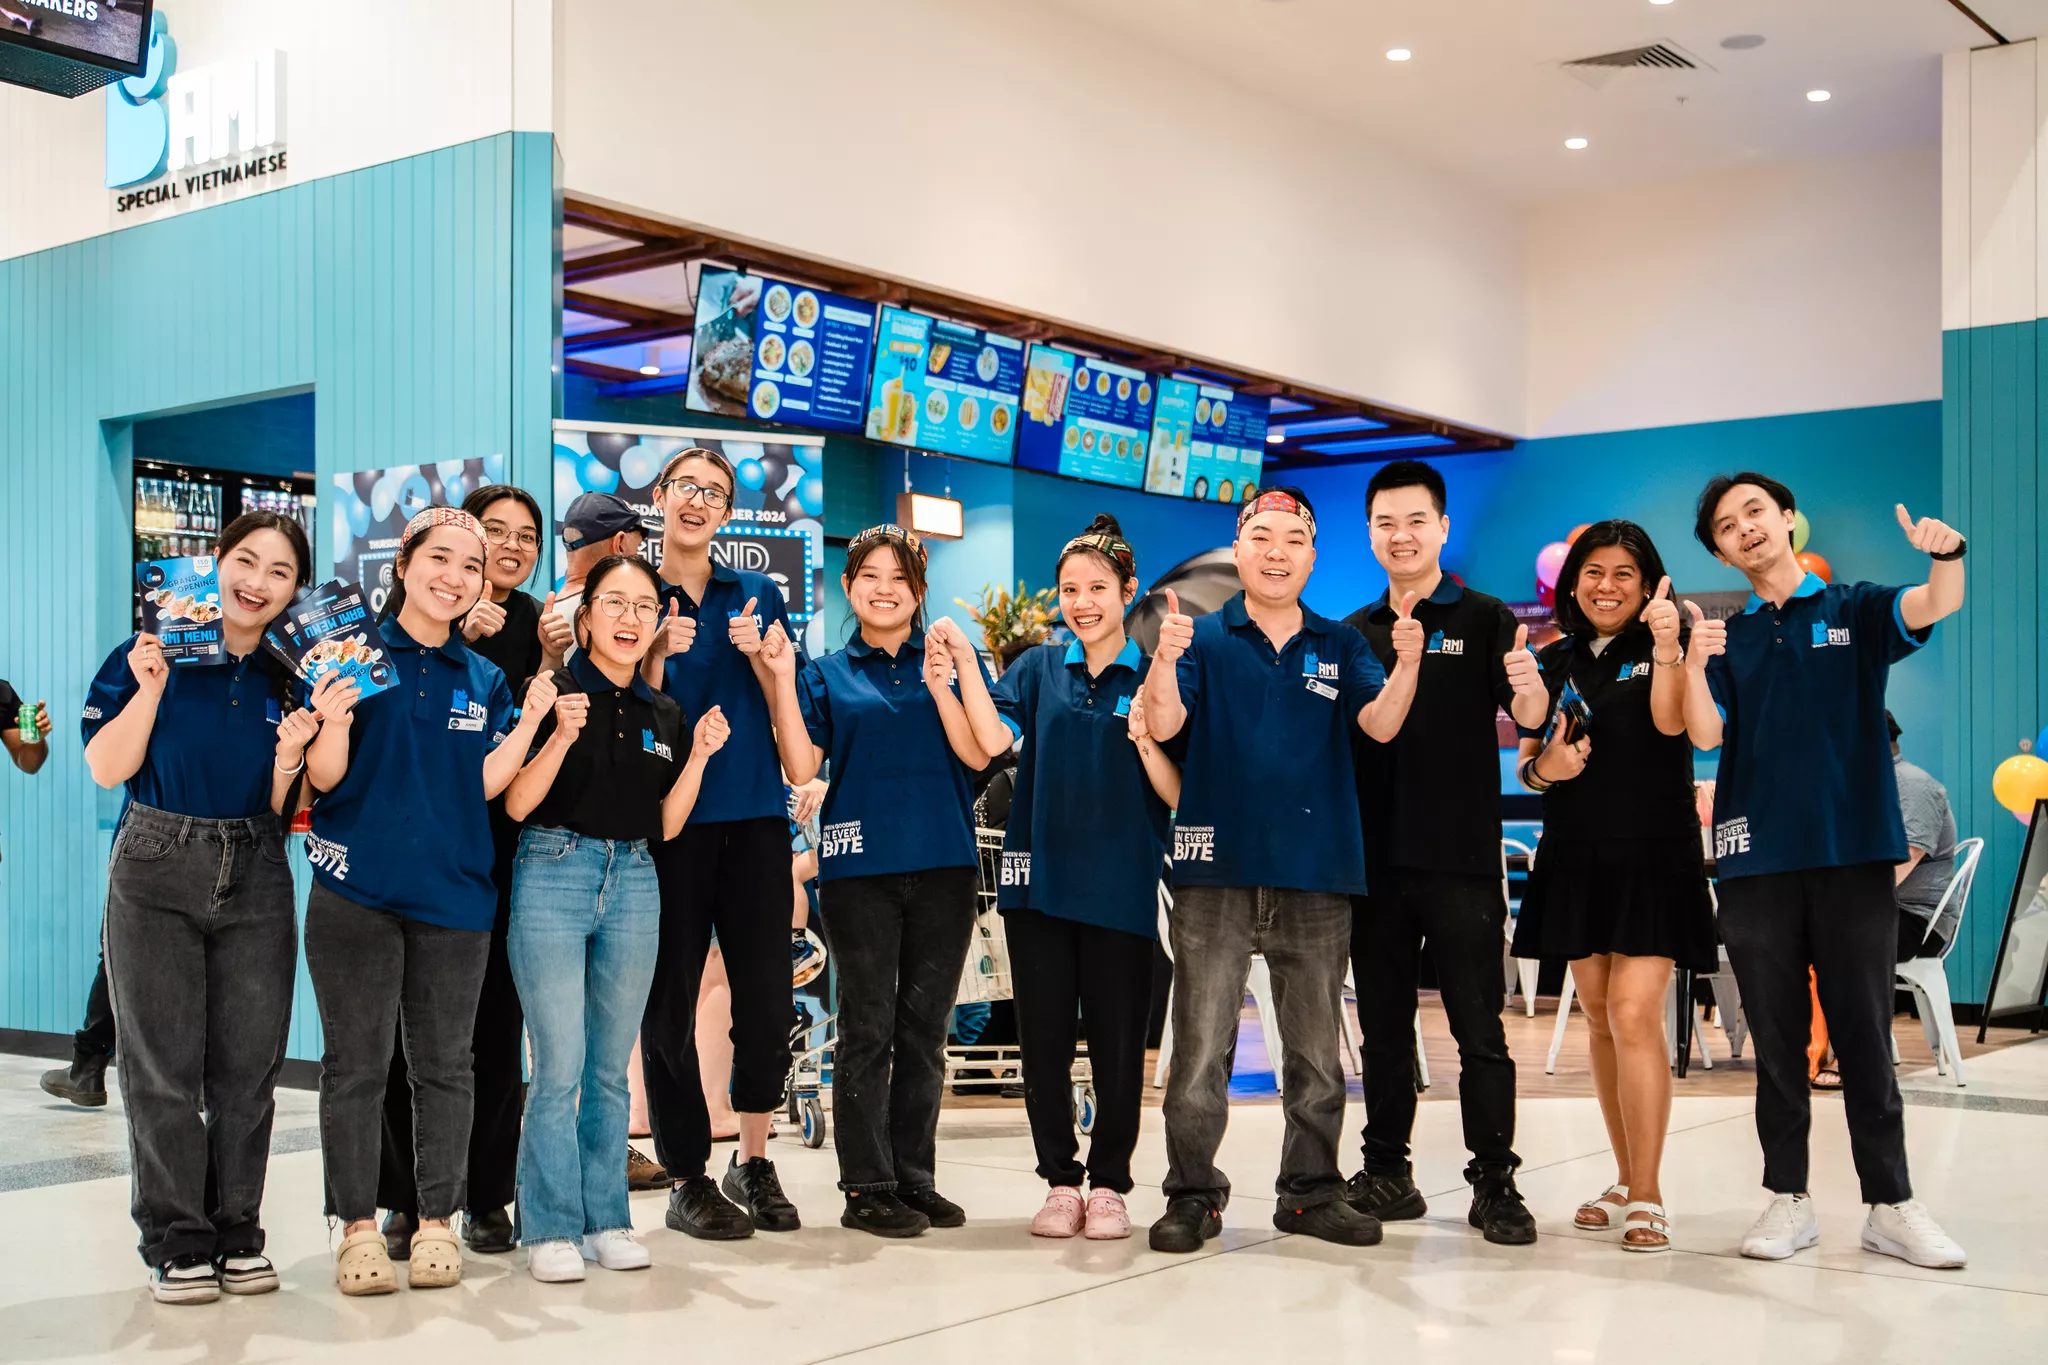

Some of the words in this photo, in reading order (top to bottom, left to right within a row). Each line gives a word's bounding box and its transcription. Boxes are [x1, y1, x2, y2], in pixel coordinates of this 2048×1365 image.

[117, 183, 180, 213] SPECIAL
[185, 151, 287, 194] VIETNAMESE
[755, 510, 787, 523] 2024
[167, 575, 198, 588] GRAND
[177, 578, 216, 593] OPENING
[338, 606, 366, 625] BAMI
[303, 616, 338, 639] MENU
[157, 632, 181, 645] AMI
[184, 629, 218, 643] MENU
[835, 820, 861, 829] GOODNESS
[1724, 822, 1749, 838] EVERY
[823, 831, 830, 841] IN
[832, 826, 861, 840] EVERY
[1174, 832, 1183, 843] IN
[1184, 832, 1214, 843] EVERY
[317, 842, 348, 864] EVERY
[320, 838, 348, 853] GOODNESS
[822, 835, 864, 858] BITE
[1173, 842, 1215, 862] BITE
[1716, 832, 1751, 859] BITE
[308, 848, 351, 881] BITE
[1002, 857, 1012, 868] IN
[1000, 867, 1031, 886] BIT
